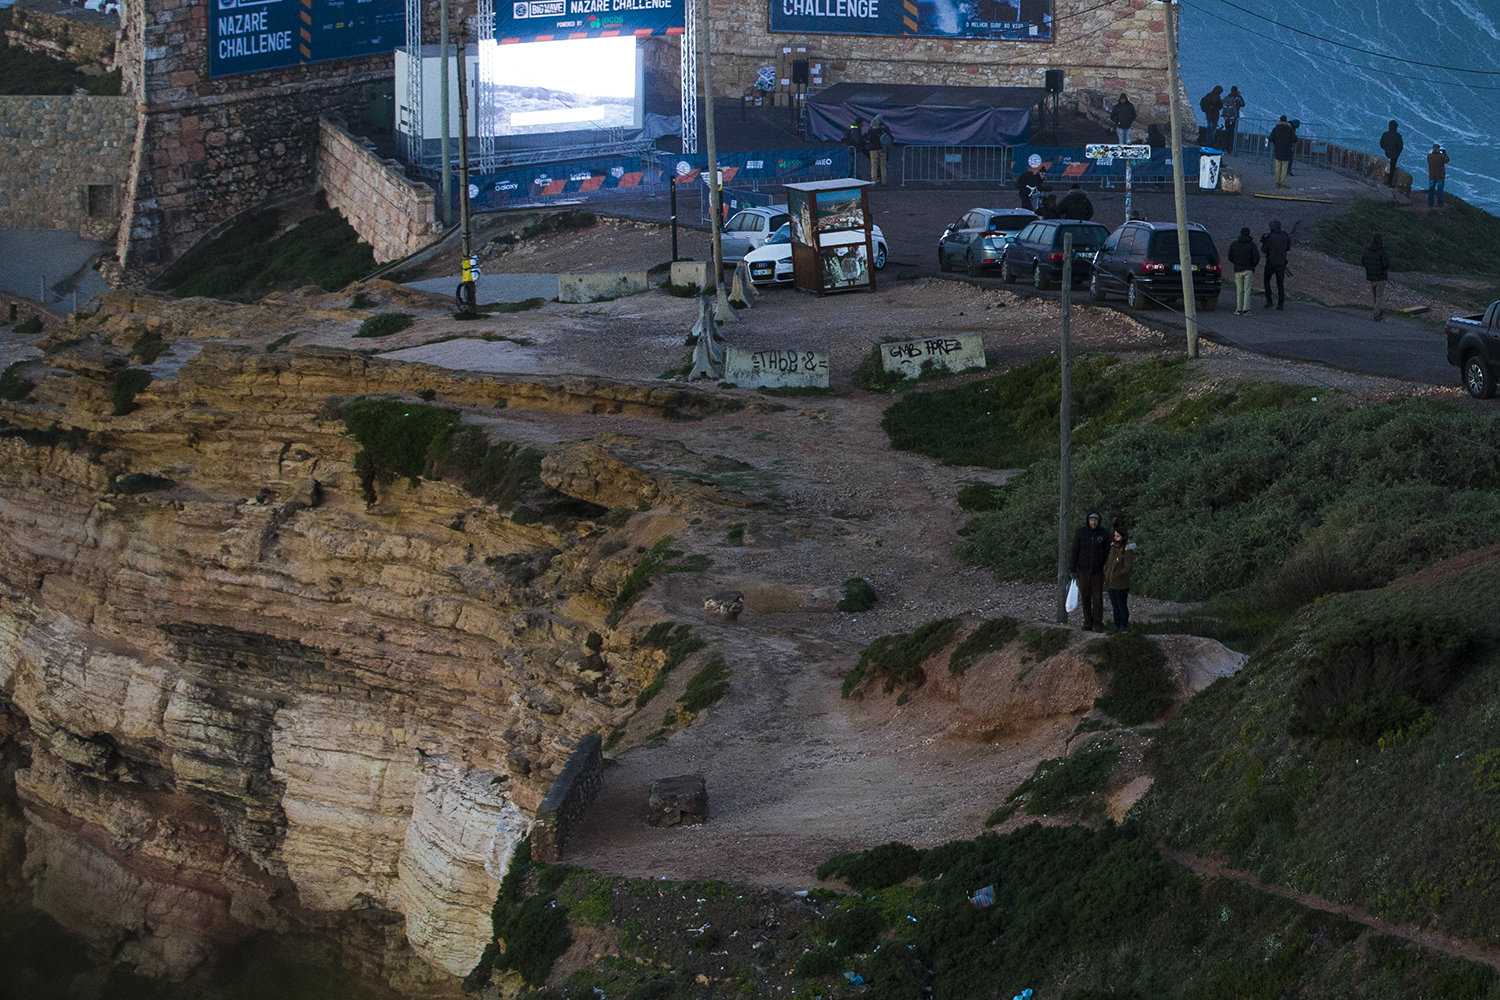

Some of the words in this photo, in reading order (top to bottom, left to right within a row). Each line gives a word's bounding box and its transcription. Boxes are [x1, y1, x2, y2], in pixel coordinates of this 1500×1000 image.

[532, 4, 544, 15] BIG
[544, 2, 563, 14] WAVE
[218, 6, 268, 37] NAZARÉ
[218, 30, 292, 59] CHALLENGE
[494, 182, 519, 192] Galaxy
